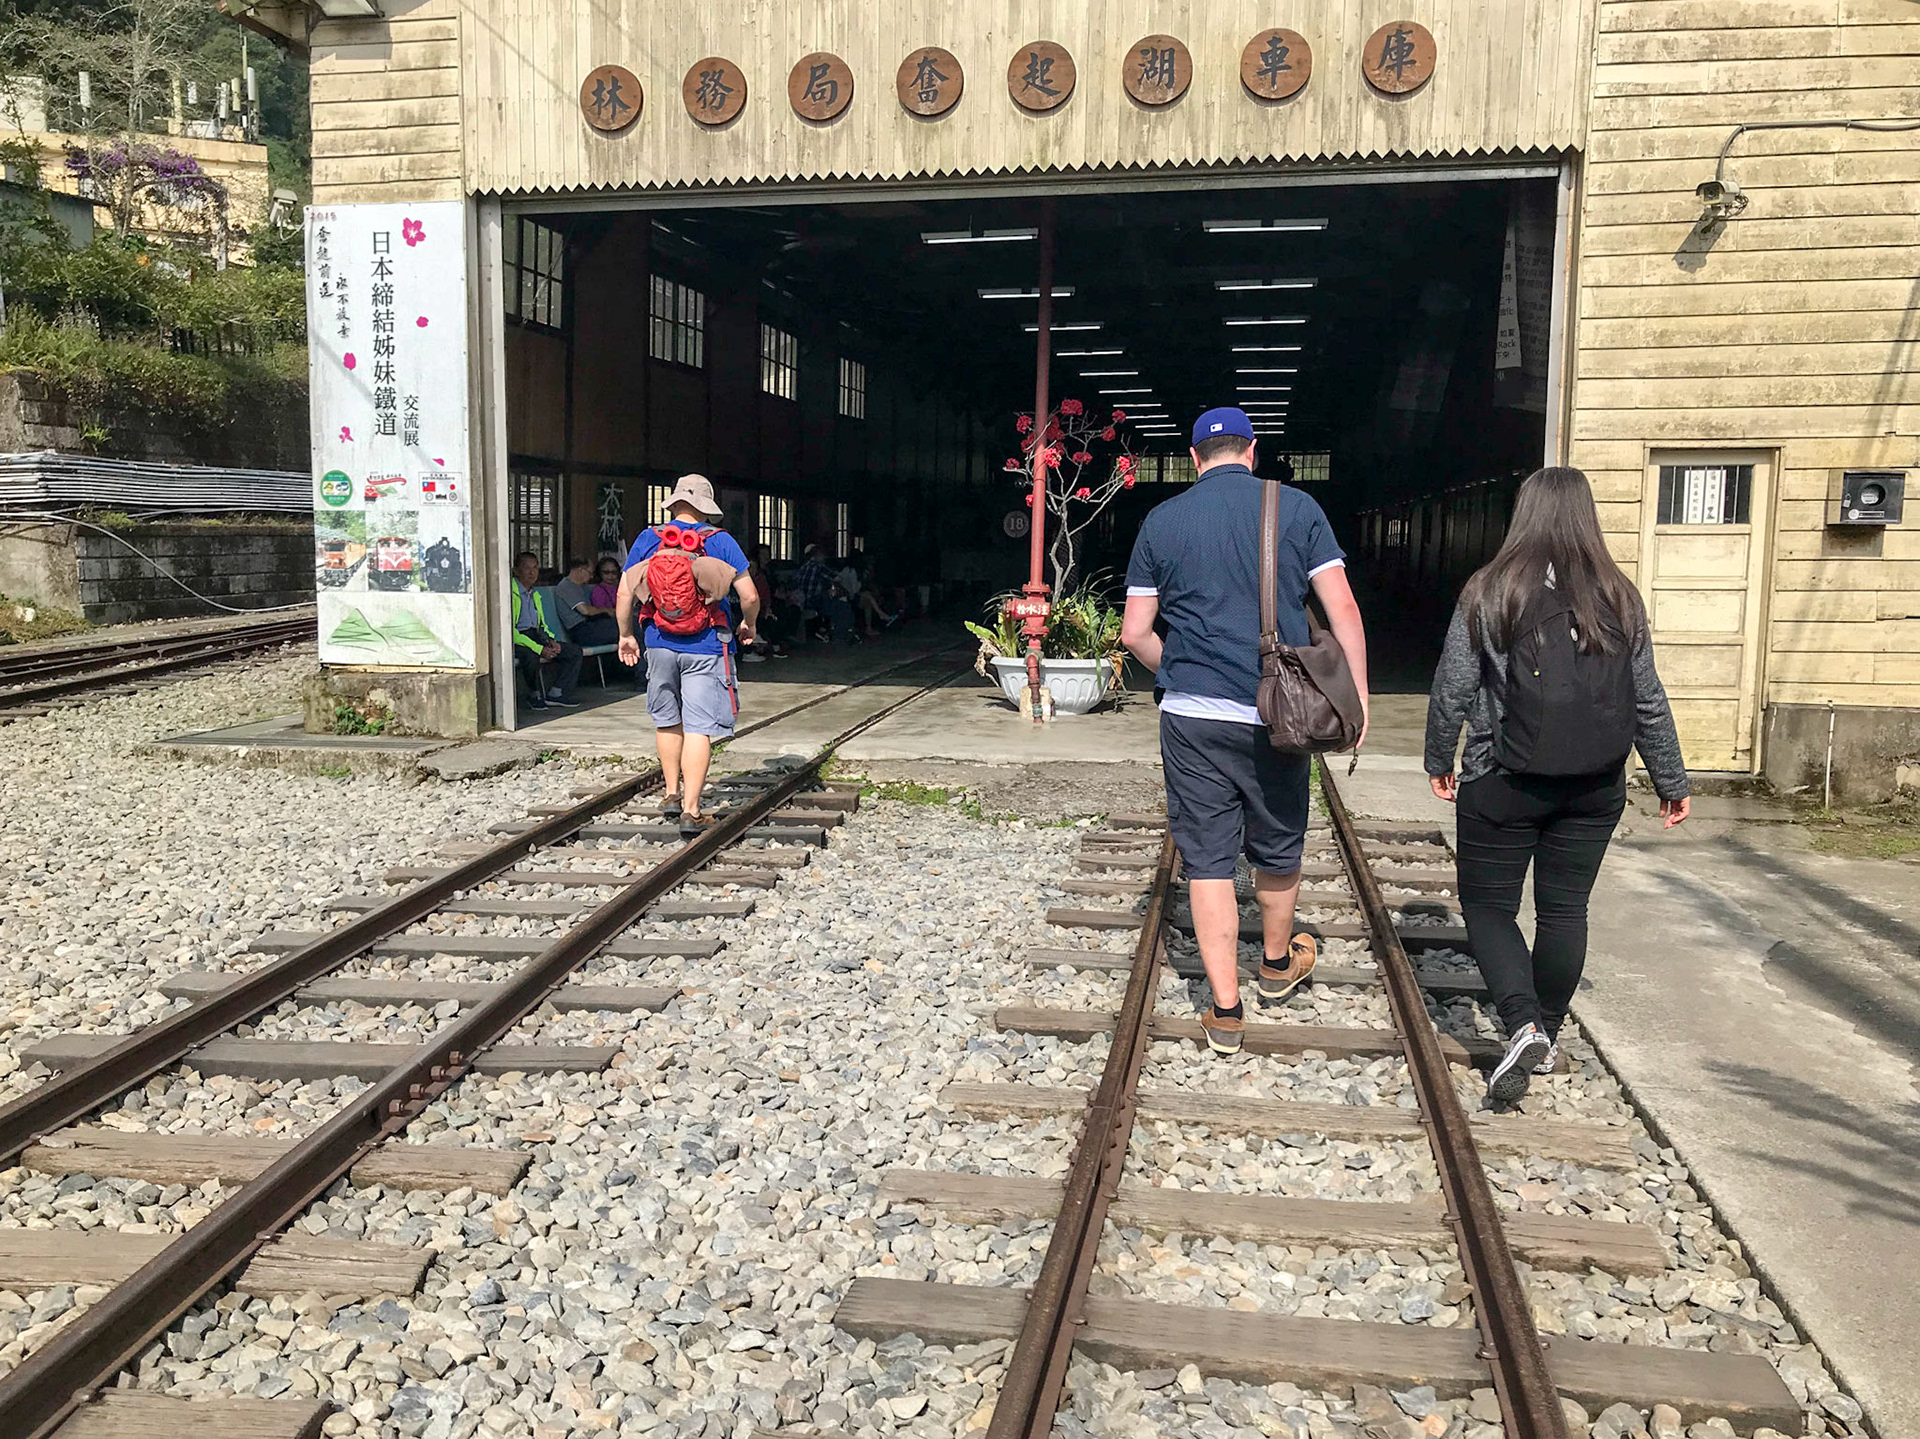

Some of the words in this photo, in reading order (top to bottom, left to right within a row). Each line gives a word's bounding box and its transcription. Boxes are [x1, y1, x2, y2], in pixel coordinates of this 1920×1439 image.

[590, 29, 1416, 120] 林務局奮起湖車庫
[371, 231, 397, 436] 日本締結姊妹鐵道
[403, 394, 420, 447] 交流展
[1009, 517, 1024, 530] 18
